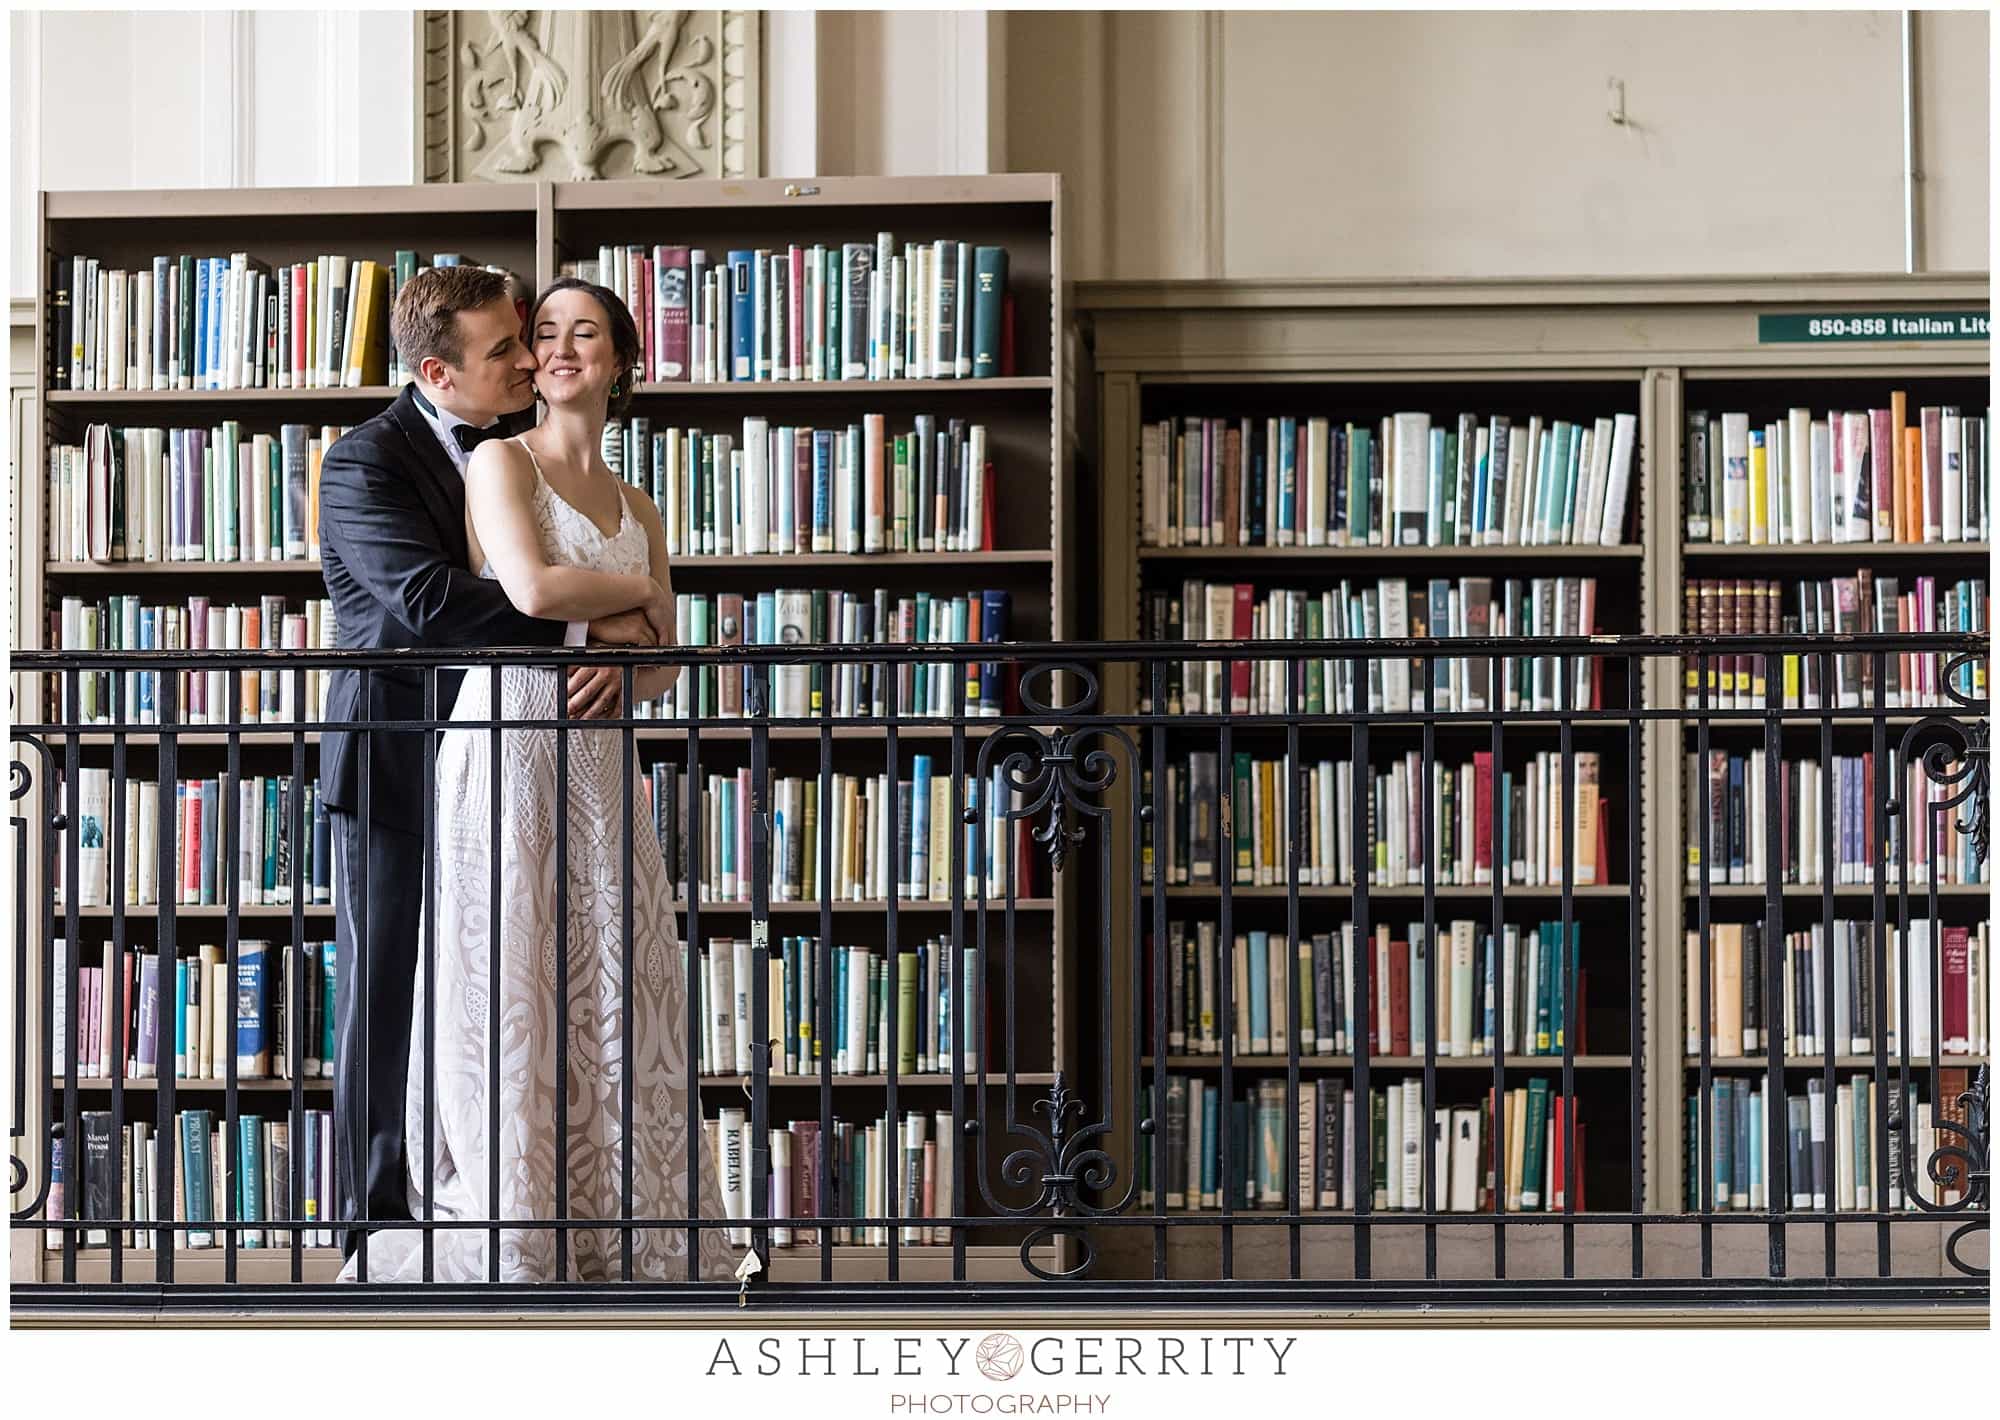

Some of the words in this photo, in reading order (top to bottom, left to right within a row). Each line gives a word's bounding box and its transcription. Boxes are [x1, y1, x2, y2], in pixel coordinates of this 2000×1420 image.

[1809, 319, 1886, 336] 850-858
[1892, 318, 1954, 335] Italian
[1889, 1087, 1900, 1109] The
[87, 1133, 109, 1142] Marcel
[87, 1142, 109, 1151] Proust
[189, 1116, 201, 1154] PROUST
[727, 1129, 741, 1193] RABELAIS
[136, 1167, 145, 1194] Proust
[801, 1168, 810, 1199] Artaud
